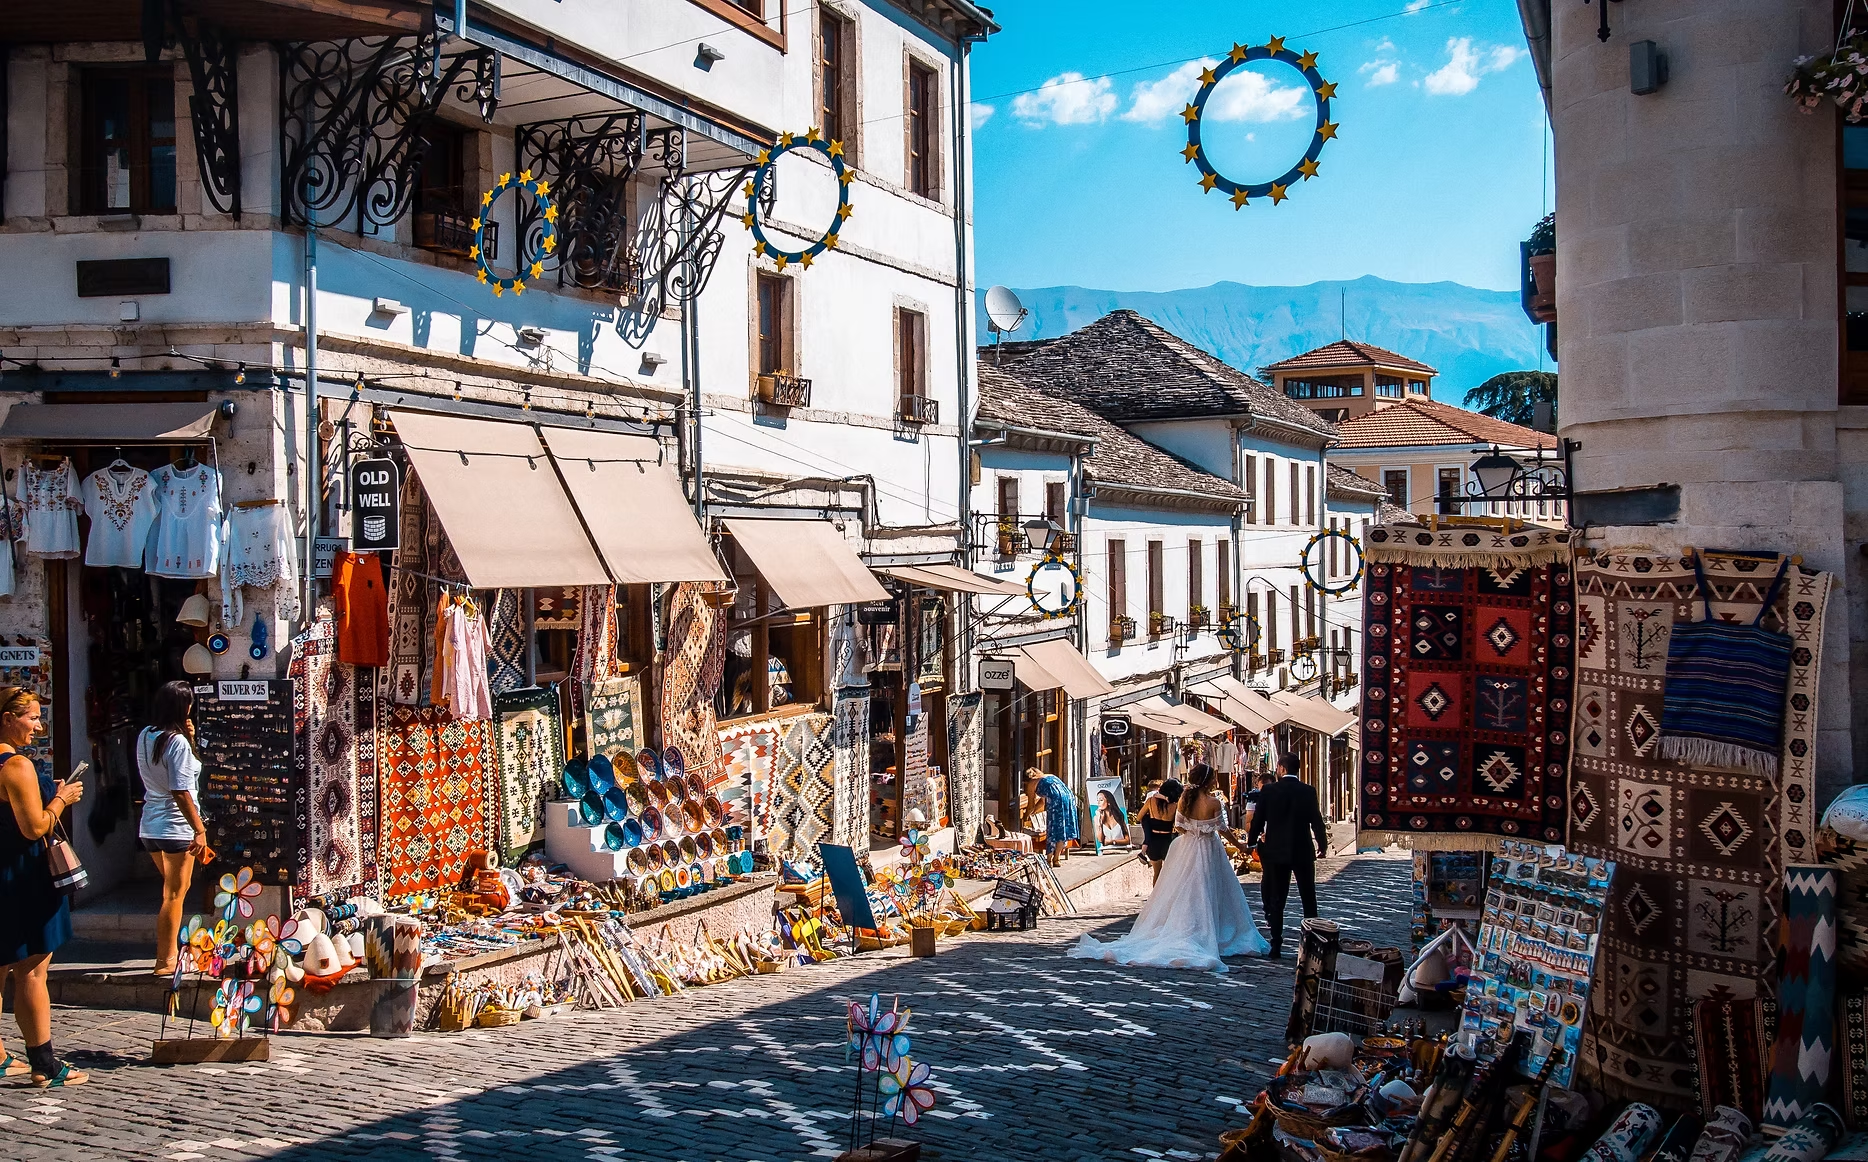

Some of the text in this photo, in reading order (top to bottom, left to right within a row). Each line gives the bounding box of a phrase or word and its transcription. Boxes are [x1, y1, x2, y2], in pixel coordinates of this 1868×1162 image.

[359, 470, 390, 486] OLD
[358, 493, 391, 508] WELL
[0, 650, 35, 661] GNETS
[221, 684, 250, 696] SILVER
[251, 684, 266, 696] 925
